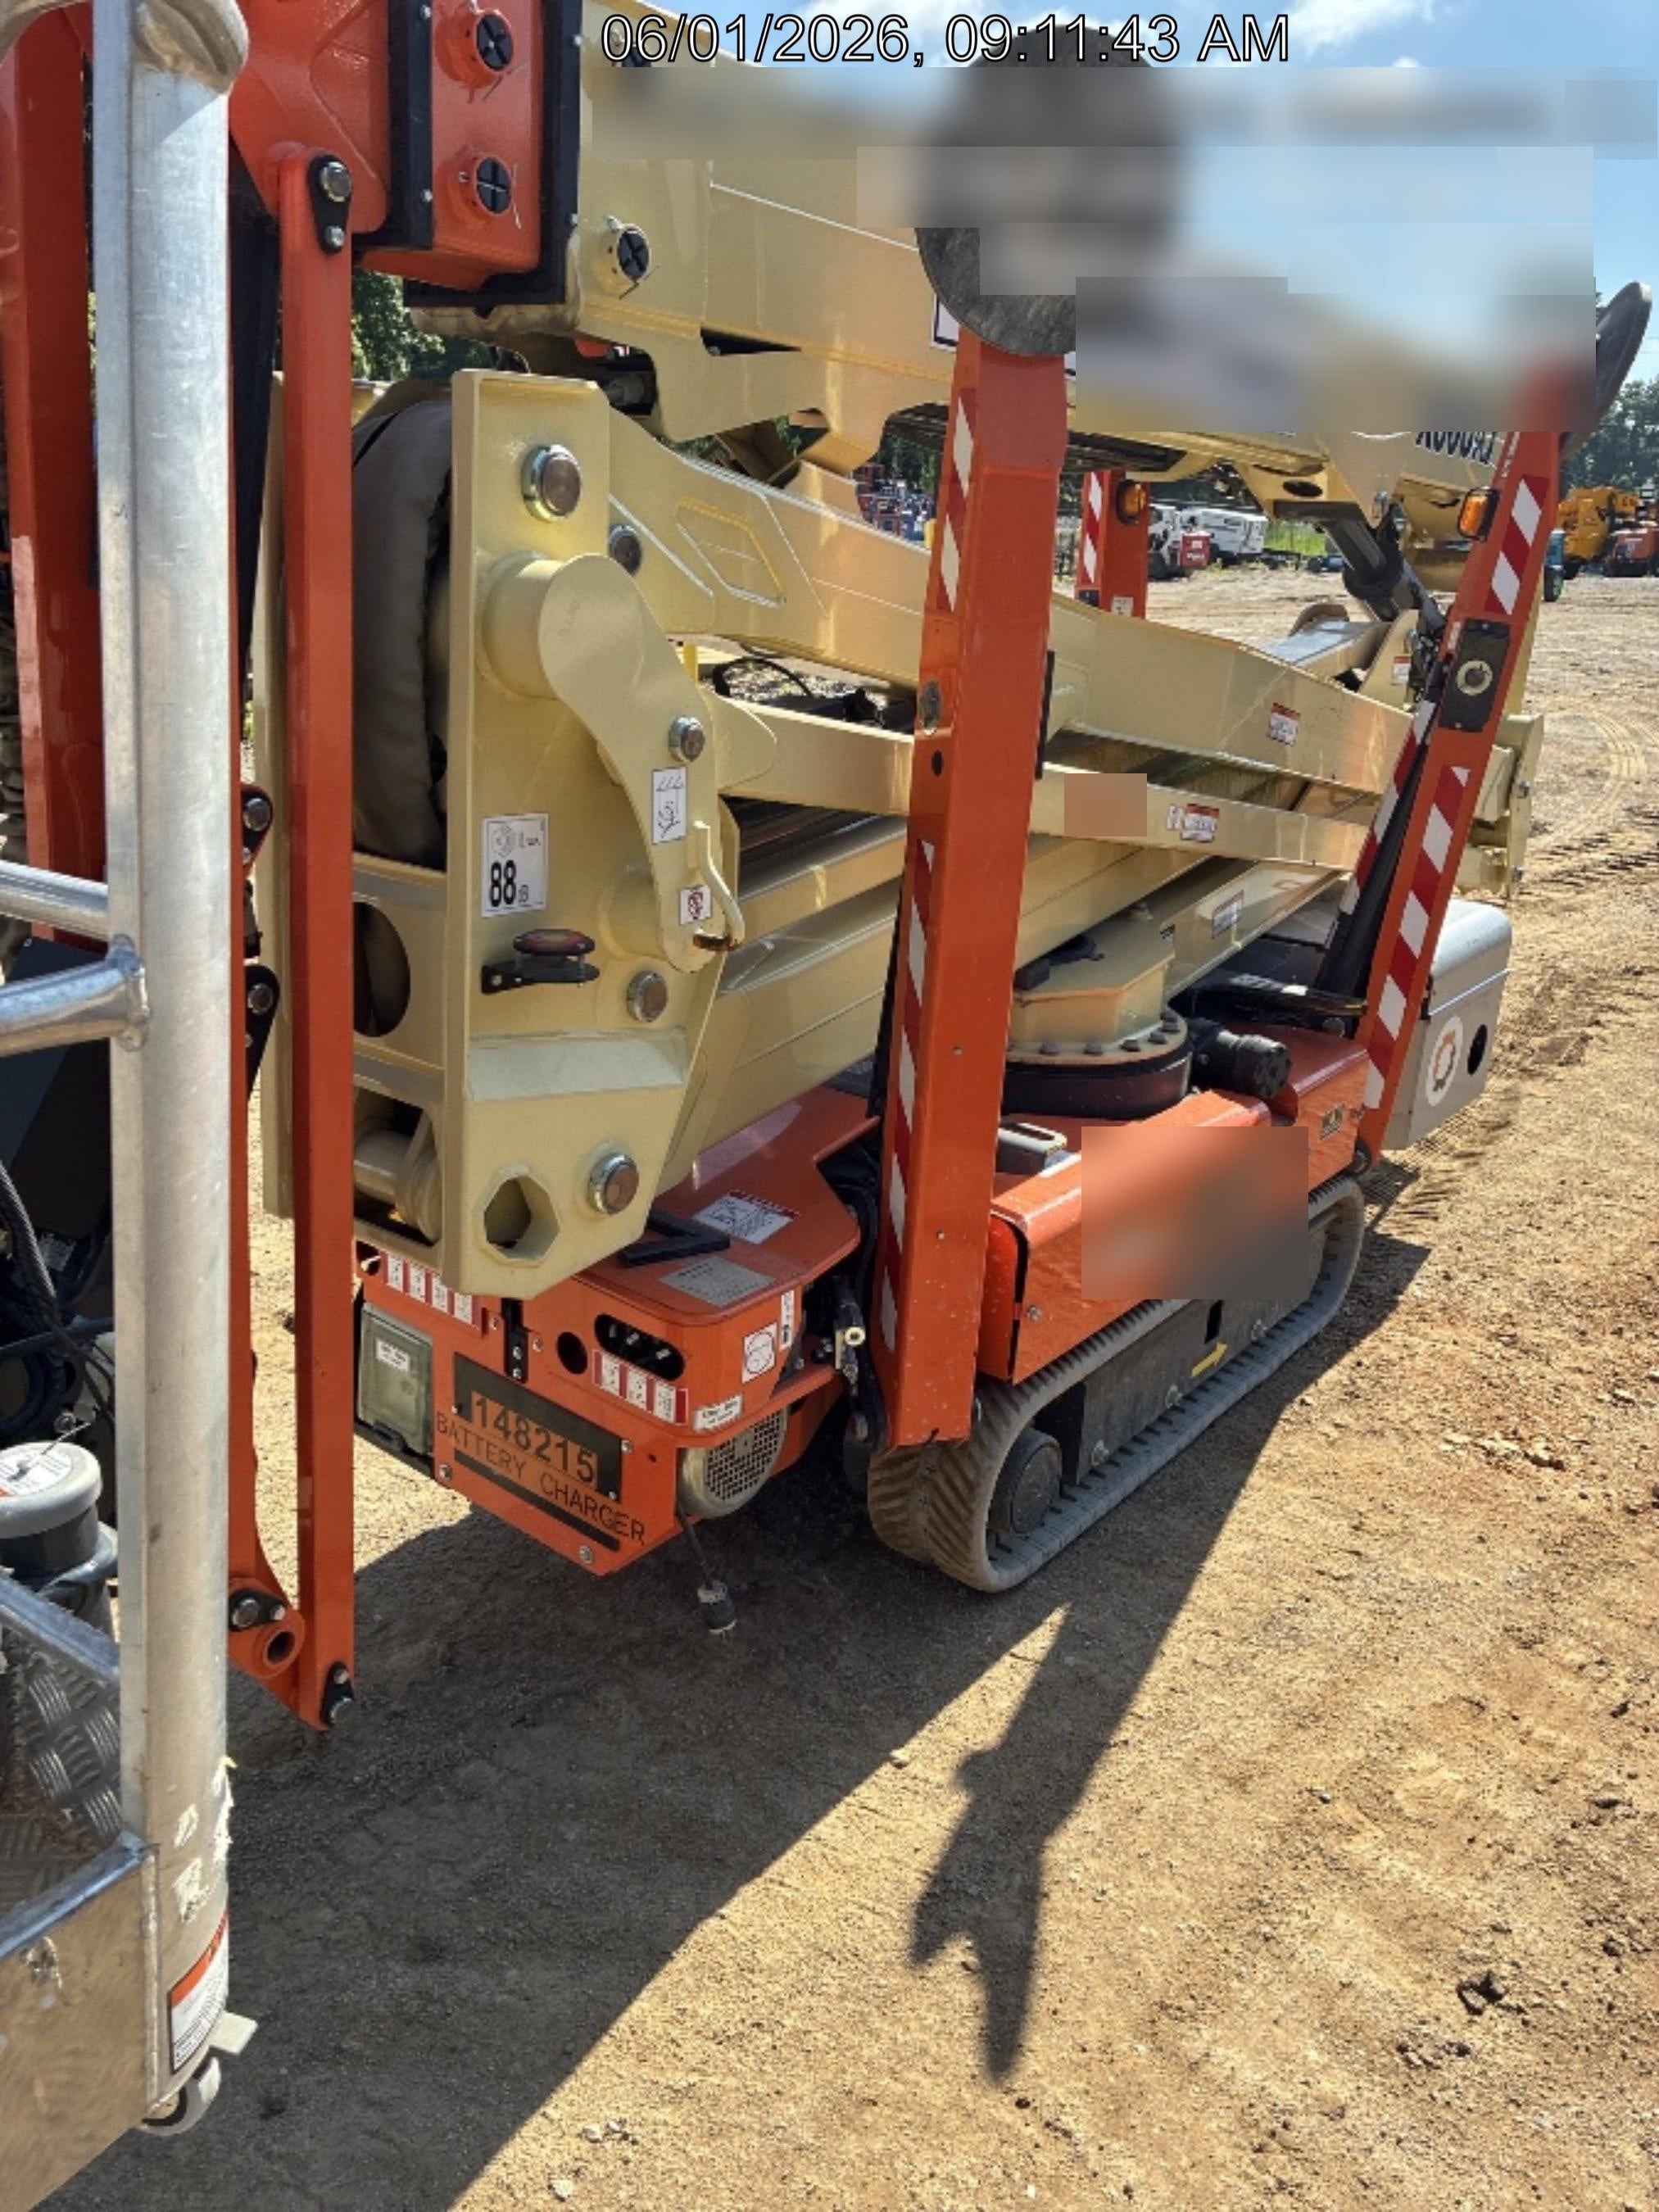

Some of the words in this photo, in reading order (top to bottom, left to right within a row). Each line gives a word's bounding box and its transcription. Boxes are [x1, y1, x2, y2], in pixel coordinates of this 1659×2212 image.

[490, 859, 516, 907] 88
[437, 1411, 526, 1479] BATTERY
[540, 1472, 645, 1543] CHARGER
[475, 1396, 595, 1484] 148215
